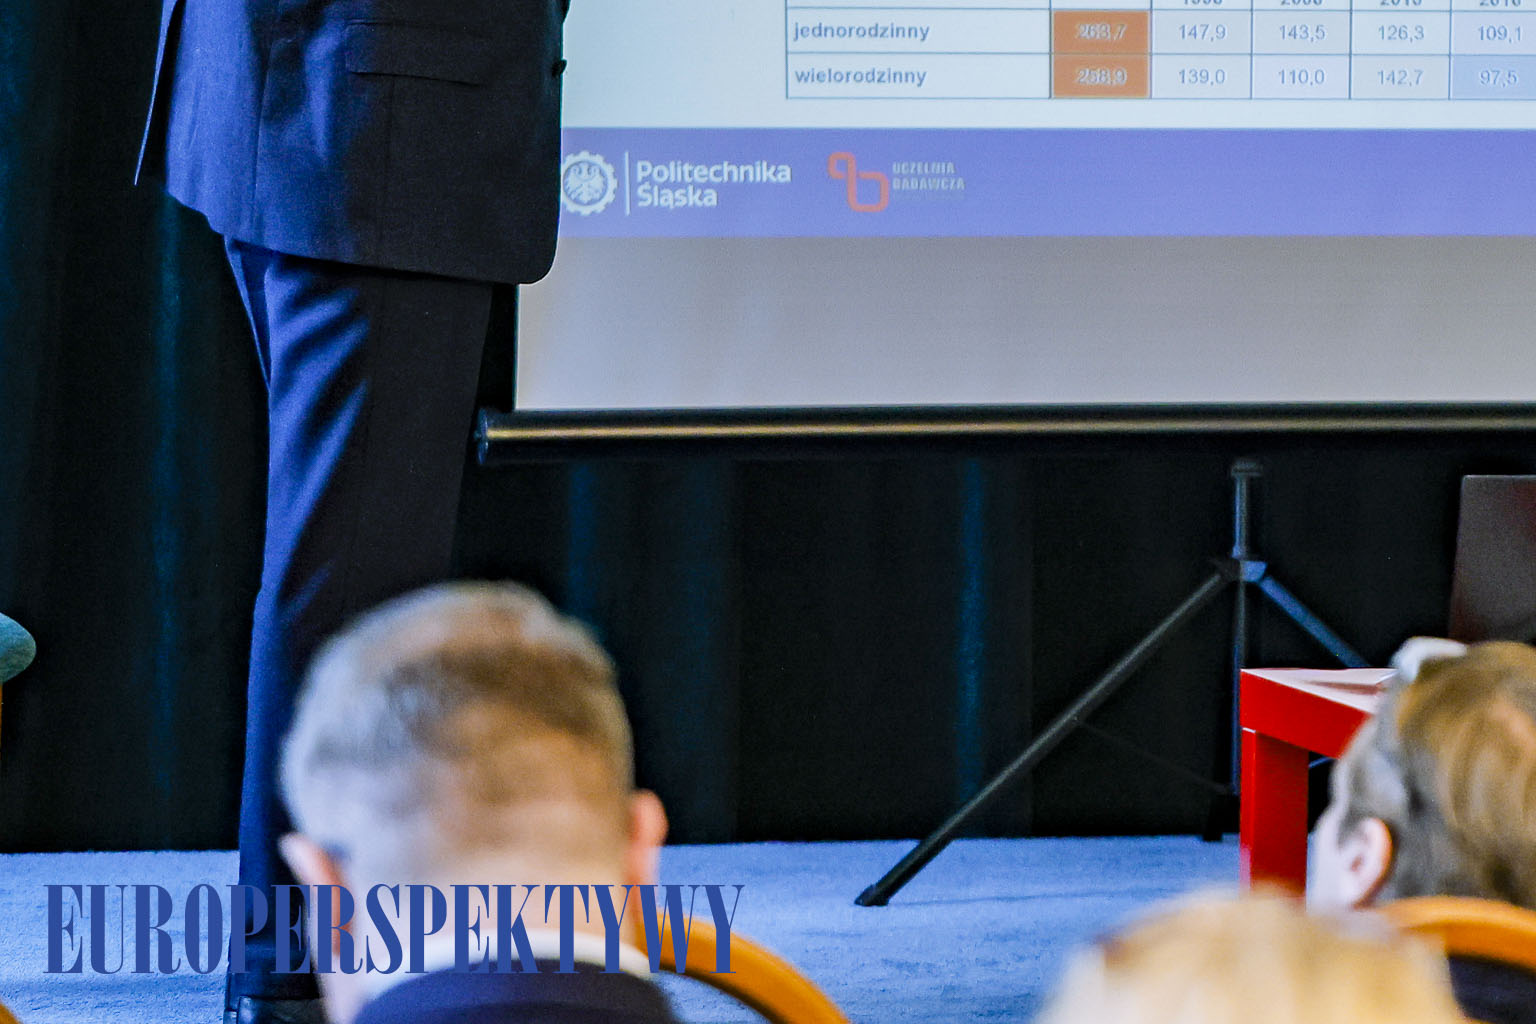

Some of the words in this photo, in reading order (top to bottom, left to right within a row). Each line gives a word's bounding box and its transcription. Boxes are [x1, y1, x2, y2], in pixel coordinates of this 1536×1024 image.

[793, 22, 930, 43] jednorodzinny
[1179, 23, 1226, 42] 147,9
[1279, 24, 1326, 43] 143,5
[1378, 24, 1425, 43] 126,3
[1478, 25, 1521, 43] 109,1
[794, 67, 927, 88] wielorodzinny
[1178, 68, 1226, 86] 139,0
[1278, 69, 1325, 86] 110,0
[1377, 69, 1424, 87] 142,7
[1480, 69, 1518, 88] 97,5
[636, 161, 792, 183] Politechnika
[636, 182, 718, 210] Śląska
